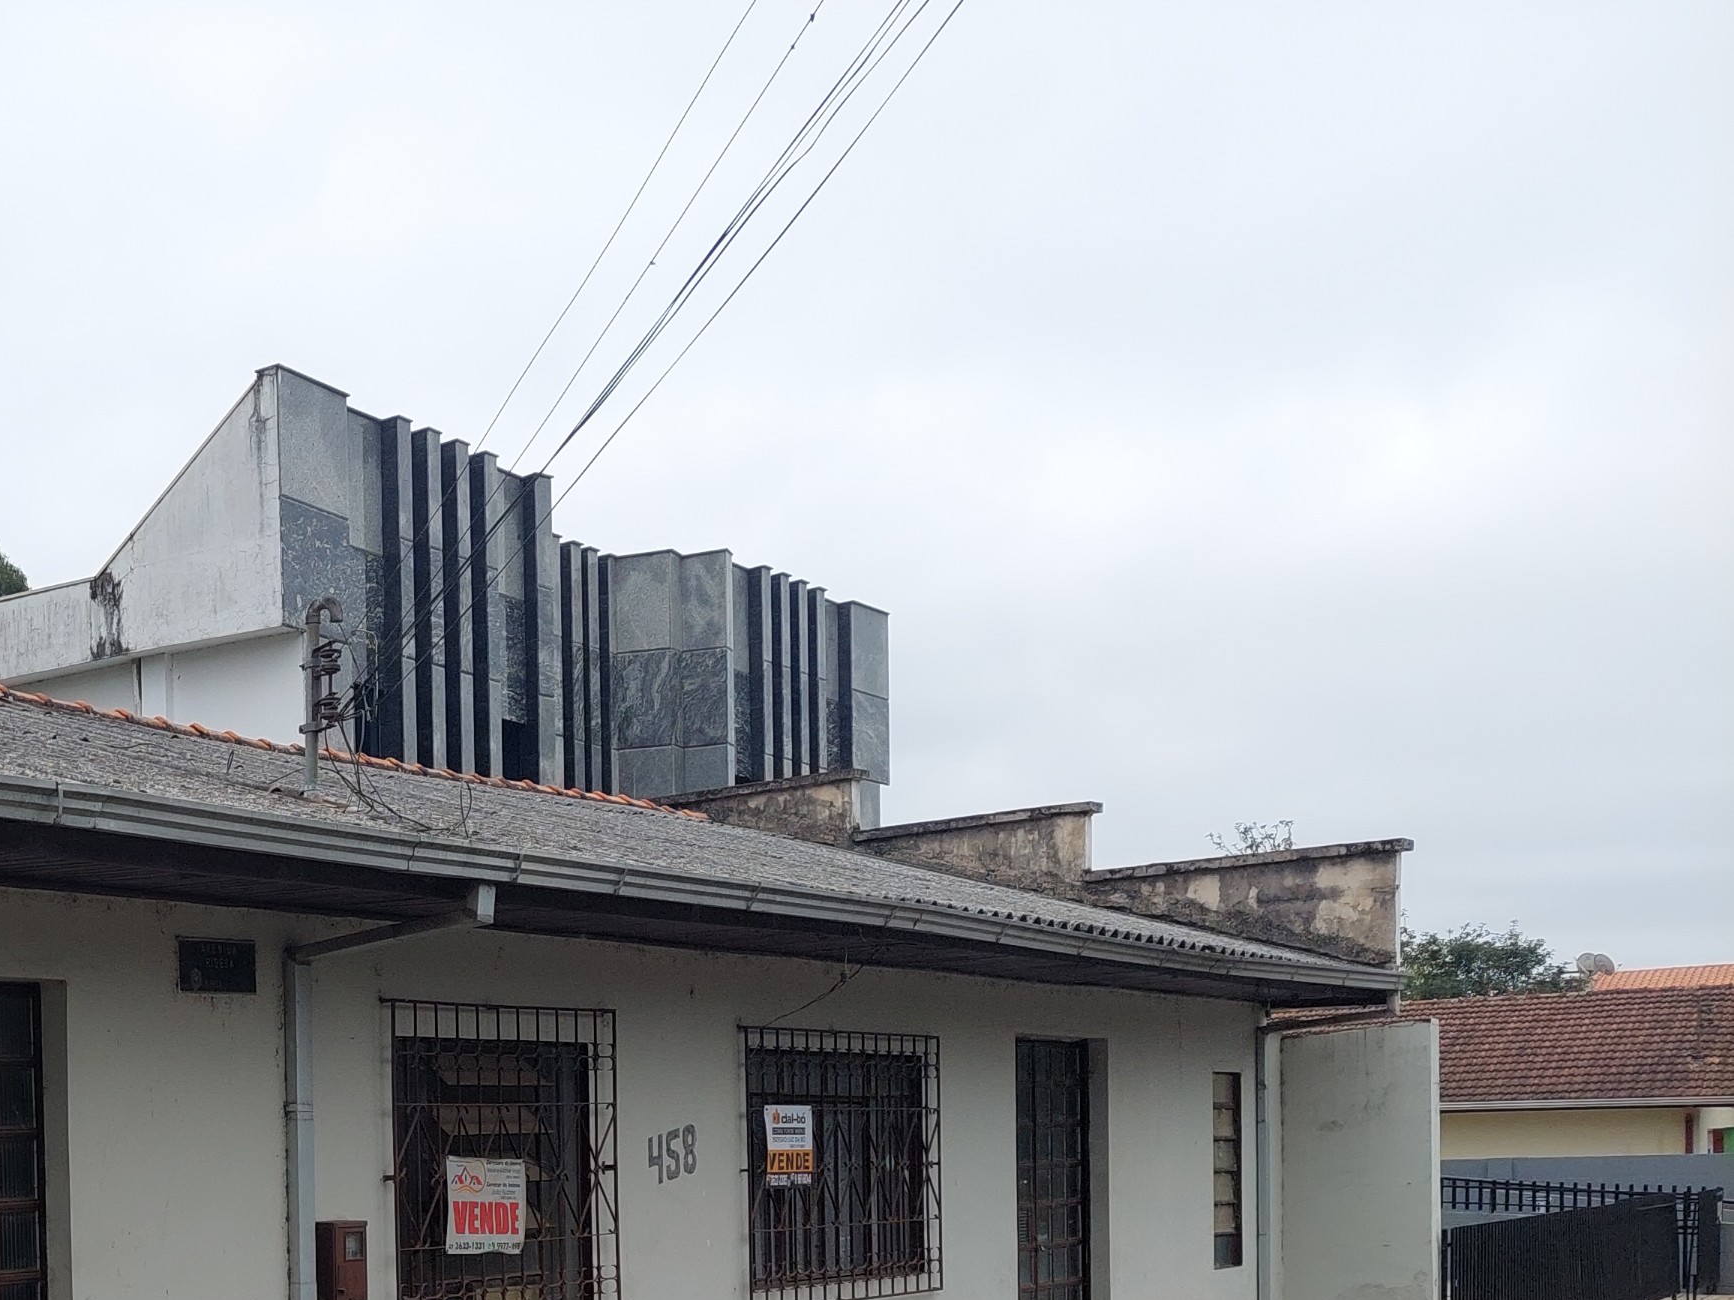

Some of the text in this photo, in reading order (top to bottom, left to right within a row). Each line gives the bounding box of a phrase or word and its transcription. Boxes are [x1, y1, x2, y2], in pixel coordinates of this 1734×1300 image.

[648, 1124, 697, 1185] 458
[769, 1152, 810, 1171] VENDE
[453, 1200, 519, 1235] VENDE
